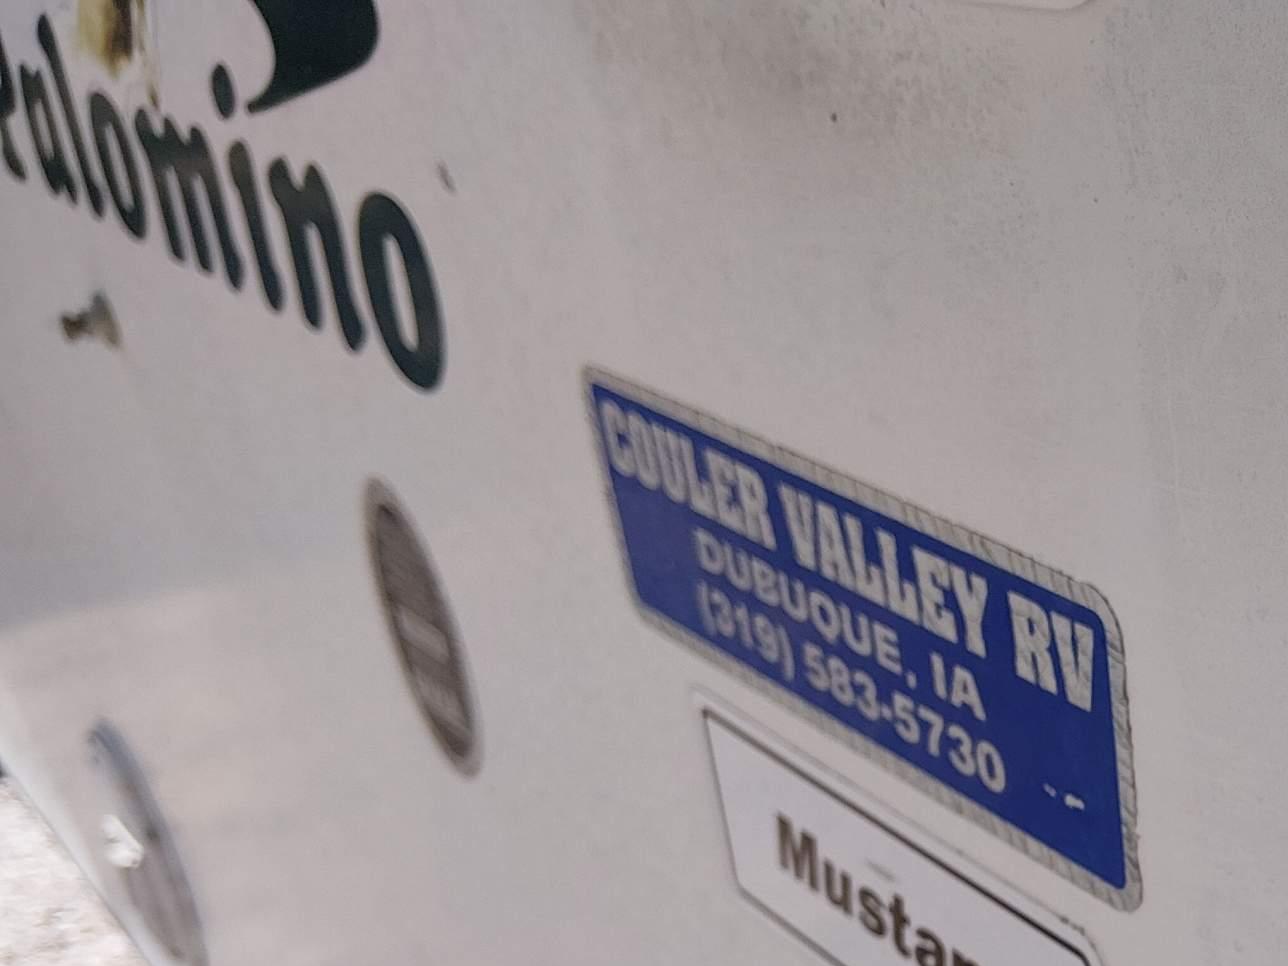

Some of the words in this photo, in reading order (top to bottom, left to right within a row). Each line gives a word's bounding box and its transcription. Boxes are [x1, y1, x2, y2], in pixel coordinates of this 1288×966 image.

[602, 400, 777, 551] COULER
[778, 481, 990, 659] VALLEY
[1007, 588, 1096, 713] RV
[697, 582, 795, 681] (319)
[803, 646, 1006, 794] 583-5730
[930, 653, 987, 721] IA
